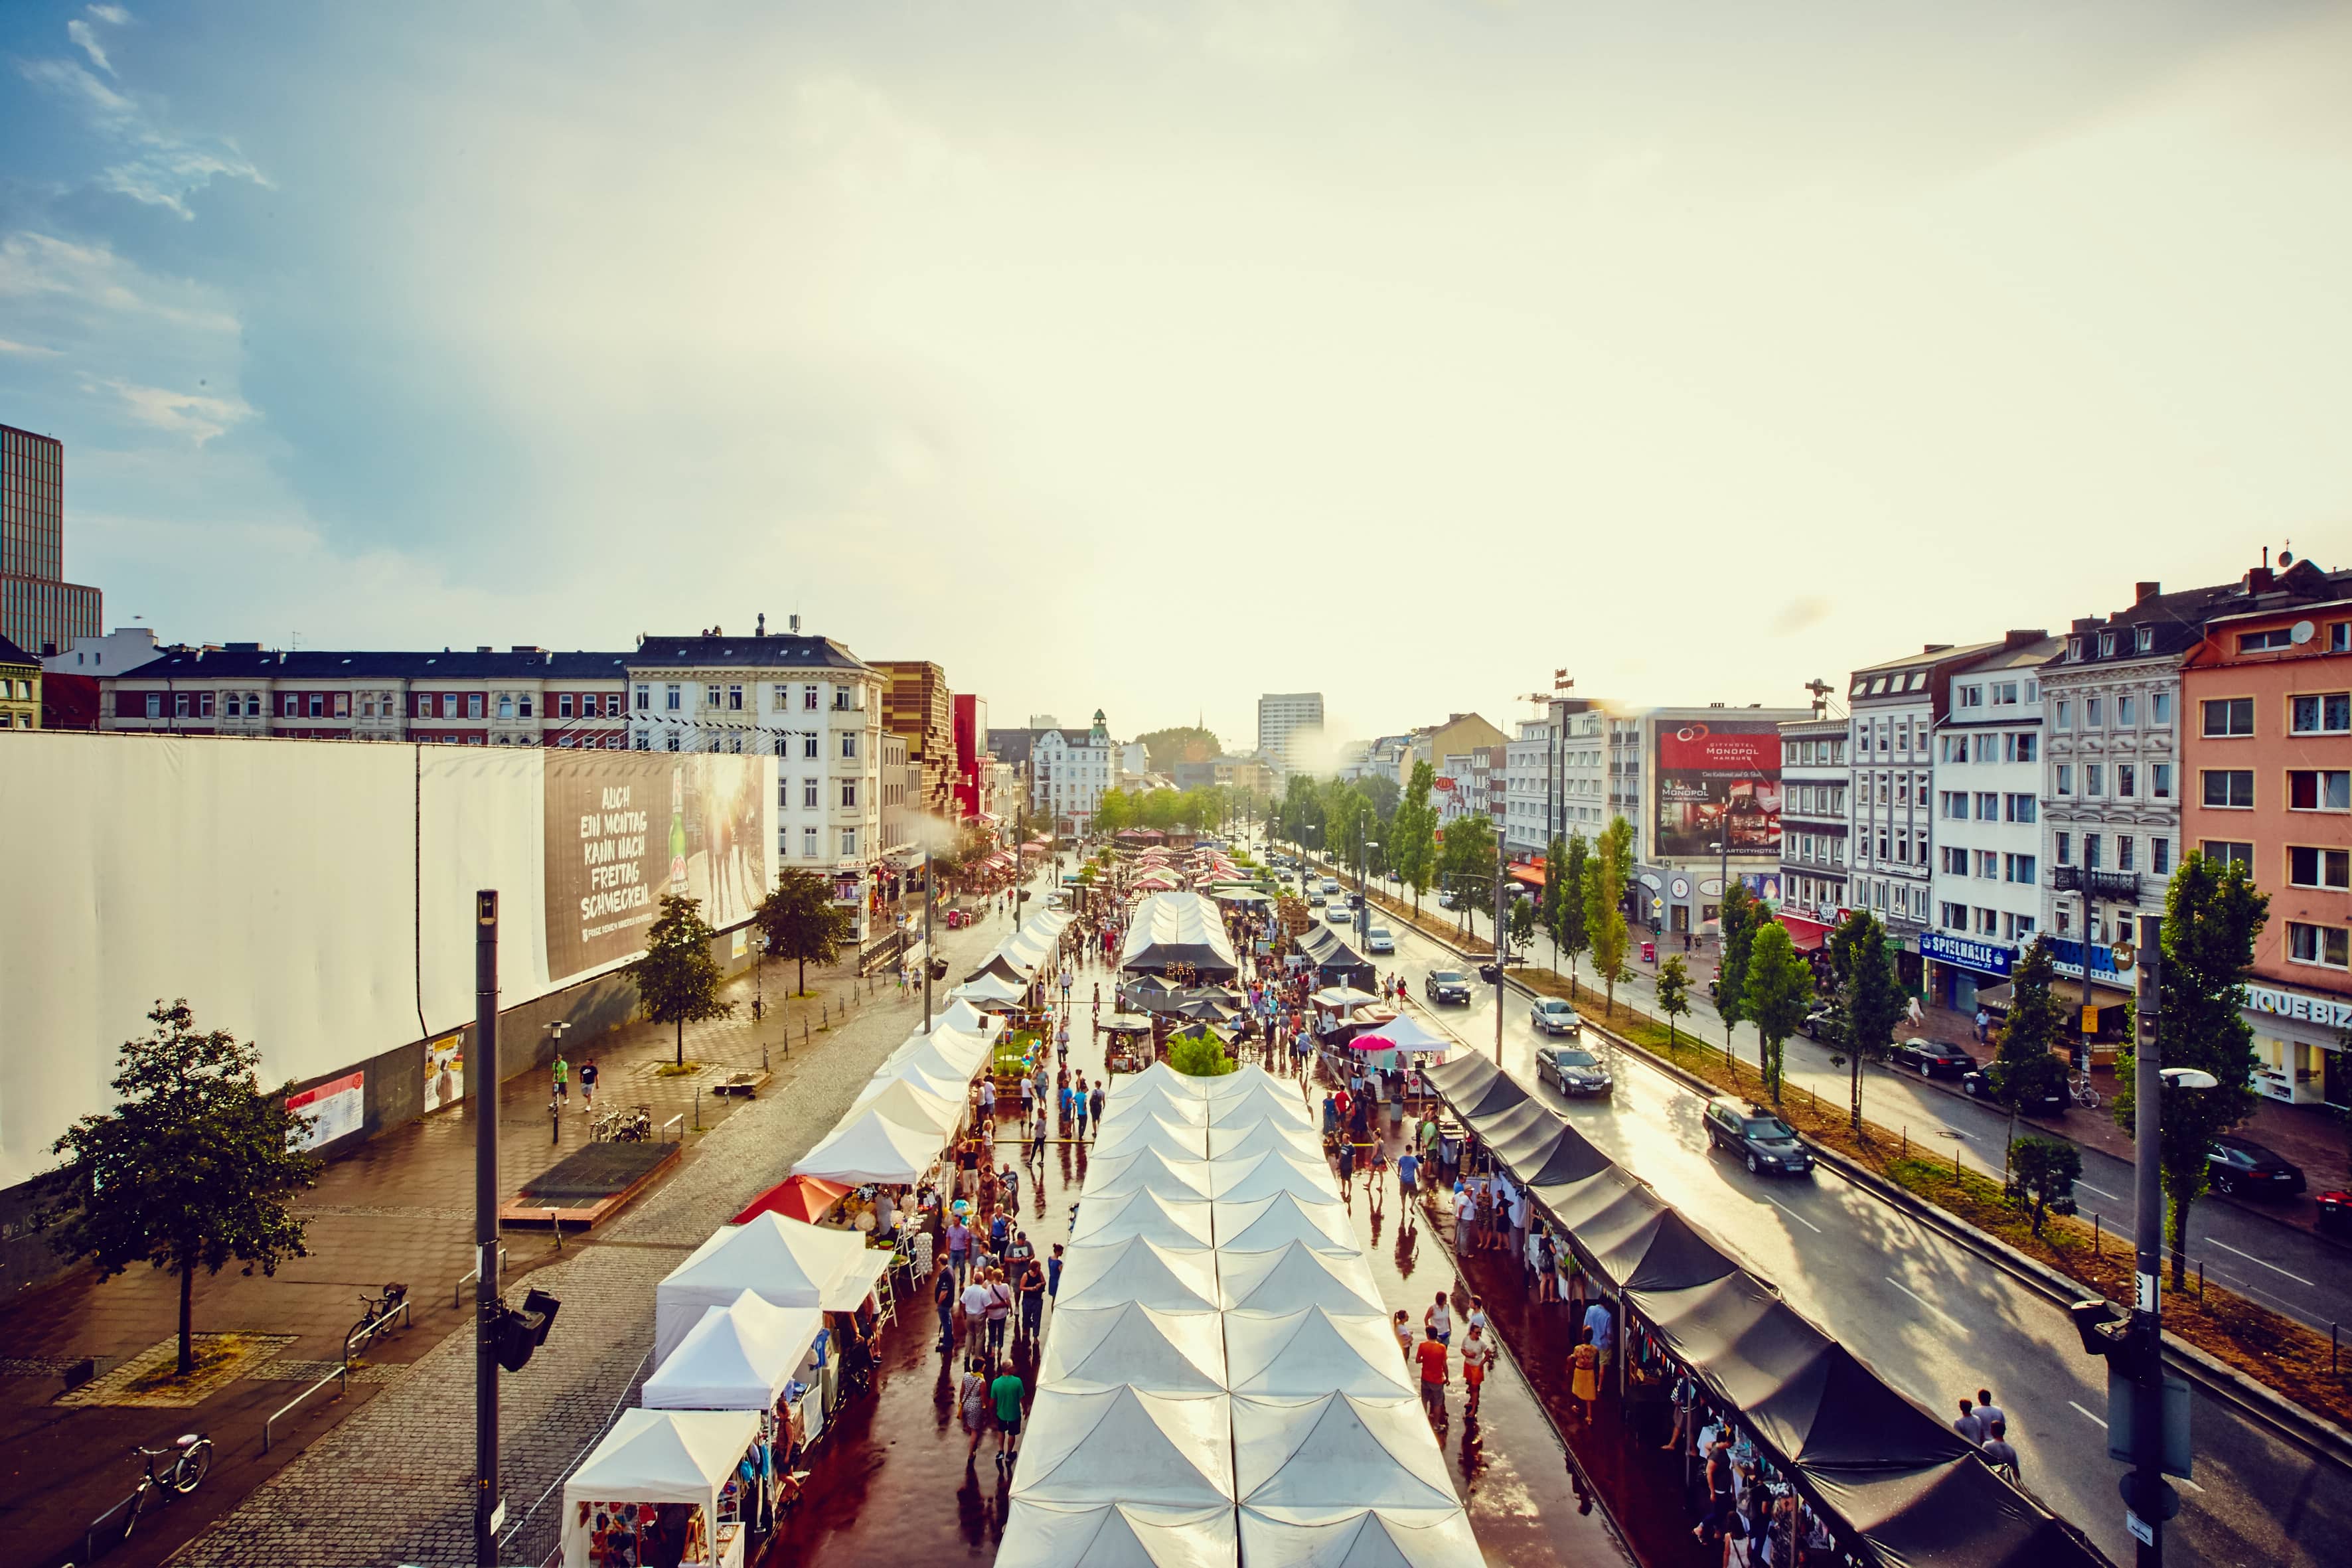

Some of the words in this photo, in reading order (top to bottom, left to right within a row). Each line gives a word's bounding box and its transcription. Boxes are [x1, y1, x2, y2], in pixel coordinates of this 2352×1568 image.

[602, 785, 630, 810] AUCH
[580, 813, 600, 838] EIN
[604, 811, 647, 836] MONTAG
[584, 838, 615, 866] KANN
[618, 835, 645, 859] NACH
[591, 861, 640, 891] FREITAG
[580, 882, 651, 920] SCHMECKEN.
[1932, 937, 1992, 963] SPIELHALLE
[1166, 961, 1196, 976] BAR
[2092, 971, 2119, 982] OSTEL
